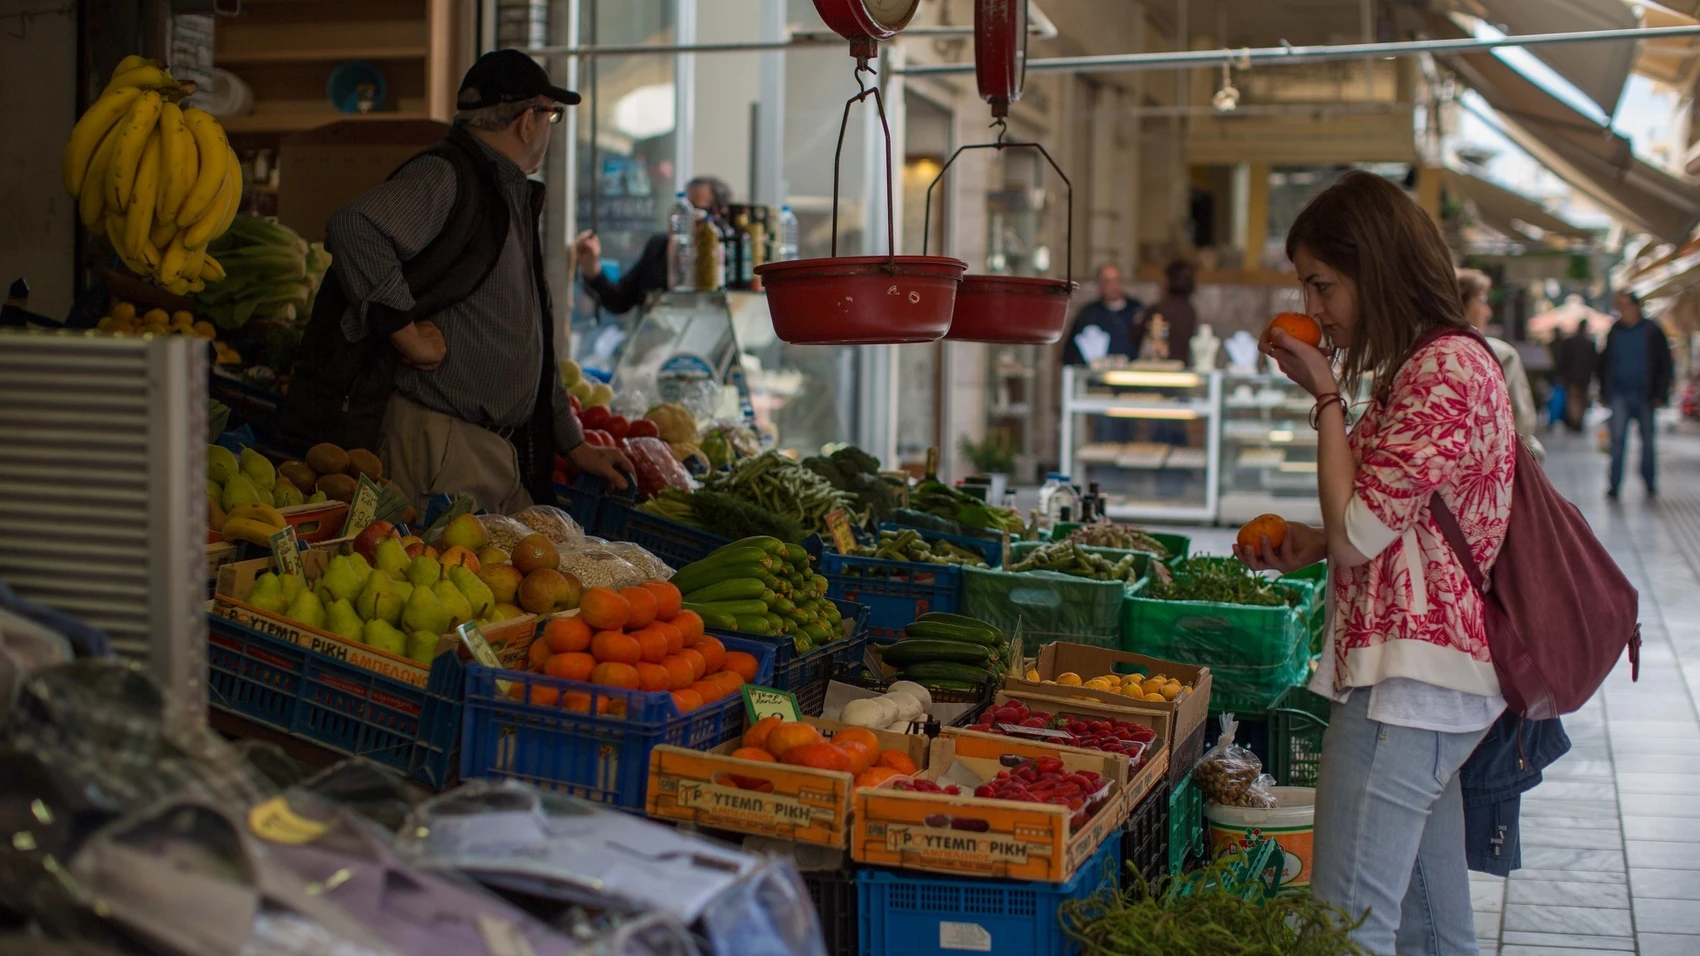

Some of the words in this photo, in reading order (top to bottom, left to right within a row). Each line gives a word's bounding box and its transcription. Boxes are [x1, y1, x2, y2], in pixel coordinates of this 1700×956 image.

[349, 651, 429, 688] ΑΜΠΕΛΩΝΟ
[680, 784, 811, 821] ΦΡΟΥΤΕΜΠΟΡΙΚΗ
[888, 826, 1028, 857] ΦΡΟΥΤΕΜΠΟΡΙΚΗ
